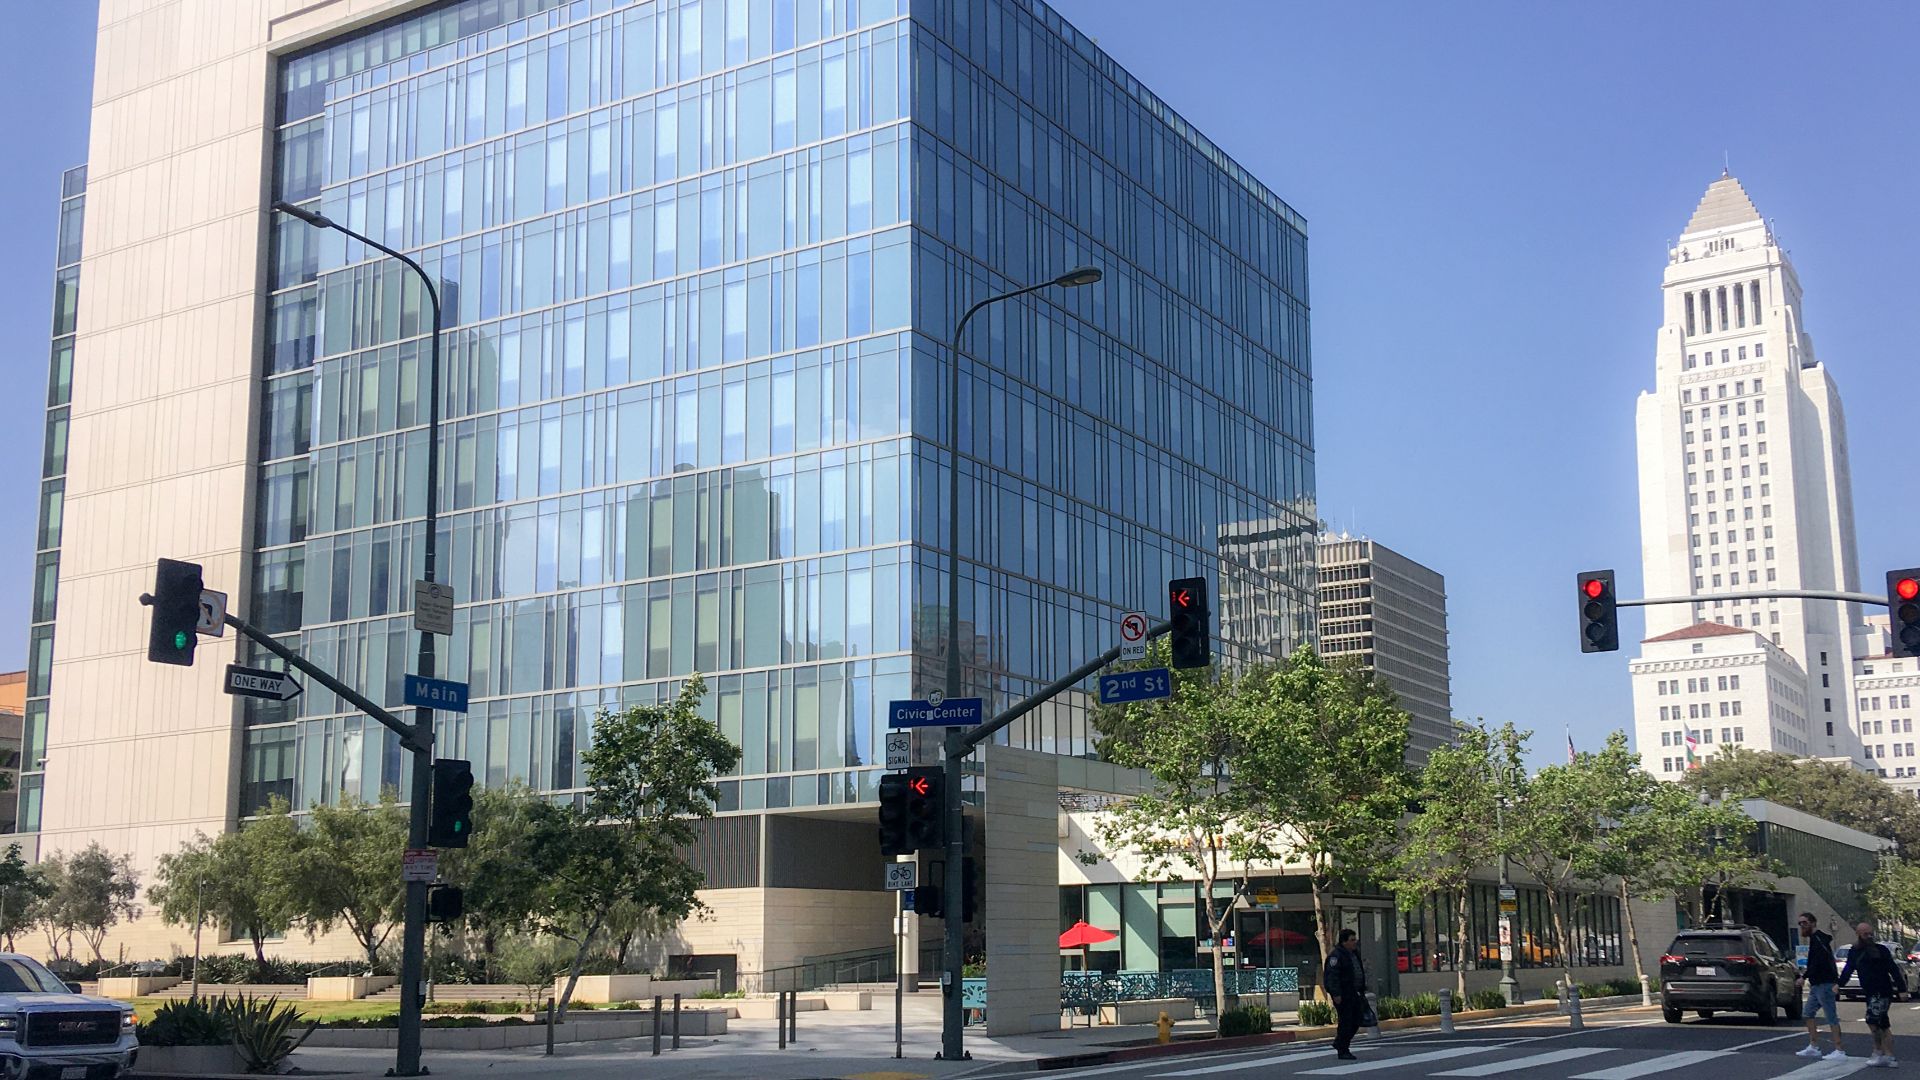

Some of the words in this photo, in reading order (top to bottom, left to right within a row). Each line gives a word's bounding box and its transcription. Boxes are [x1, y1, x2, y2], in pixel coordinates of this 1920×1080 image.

[1123, 647, 1131, 655] ON
[1133, 645, 1144, 654] RED
[234, 675, 257, 688] ONE
[260, 679, 282, 691] WAY
[1106, 677, 1136, 699] 2nd
[1144, 676, 1164, 692] St
[416, 682, 457, 702] Main
[897, 708, 925, 720] Civic
[933, 707, 975, 718] Center
[888, 756, 909, 765] SIGNAL
